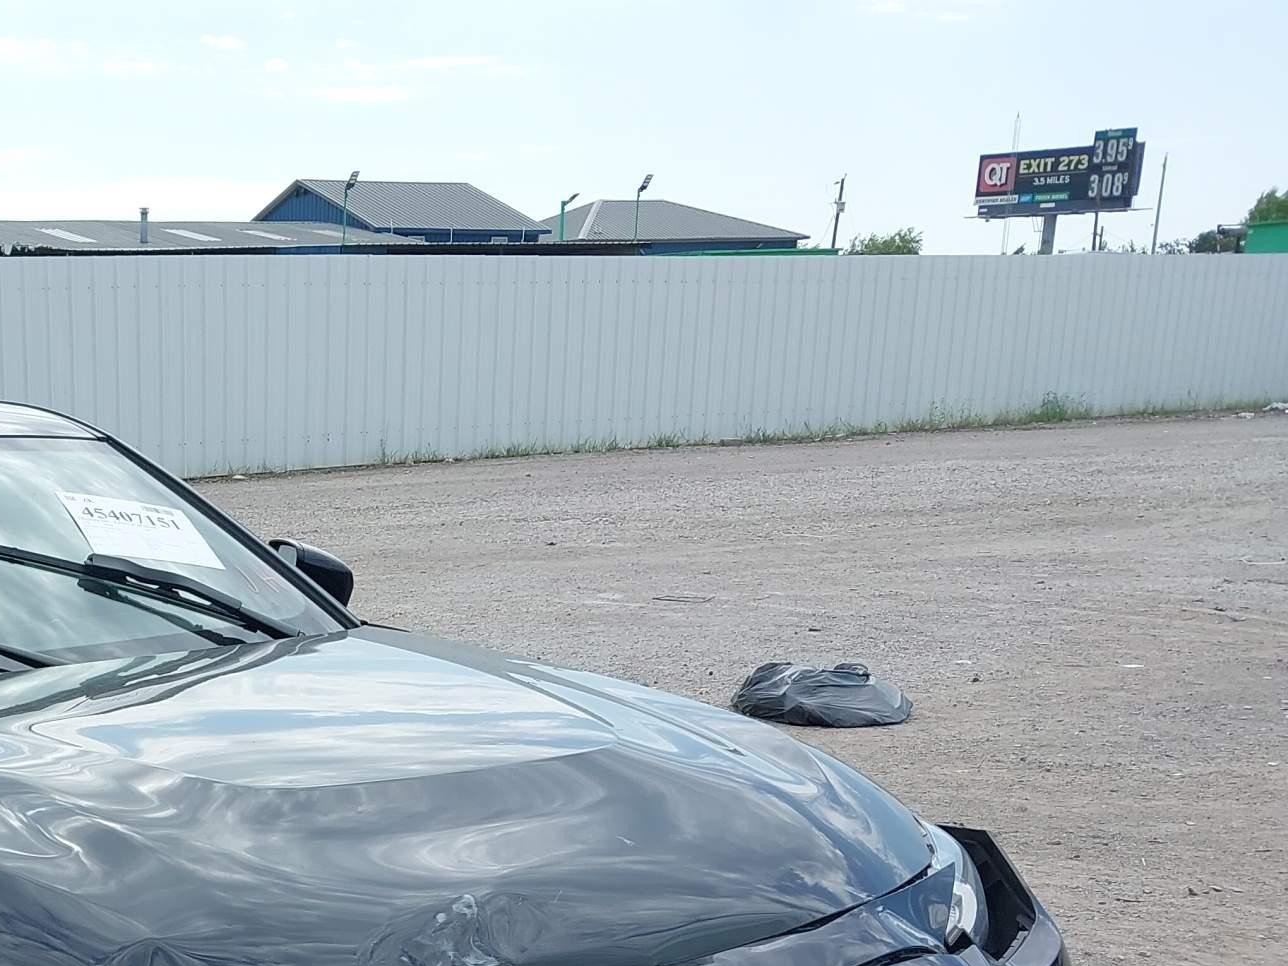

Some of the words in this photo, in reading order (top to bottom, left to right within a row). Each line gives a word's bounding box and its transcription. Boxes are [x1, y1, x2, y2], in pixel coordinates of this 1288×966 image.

[1019, 157, 1055, 174] EXIT
[1057, 154, 1089, 171] 273
[984, 162, 1011, 188] QT
[1046, 175, 1070, 185] MILES
[82, 507, 181, 530] 45407151
